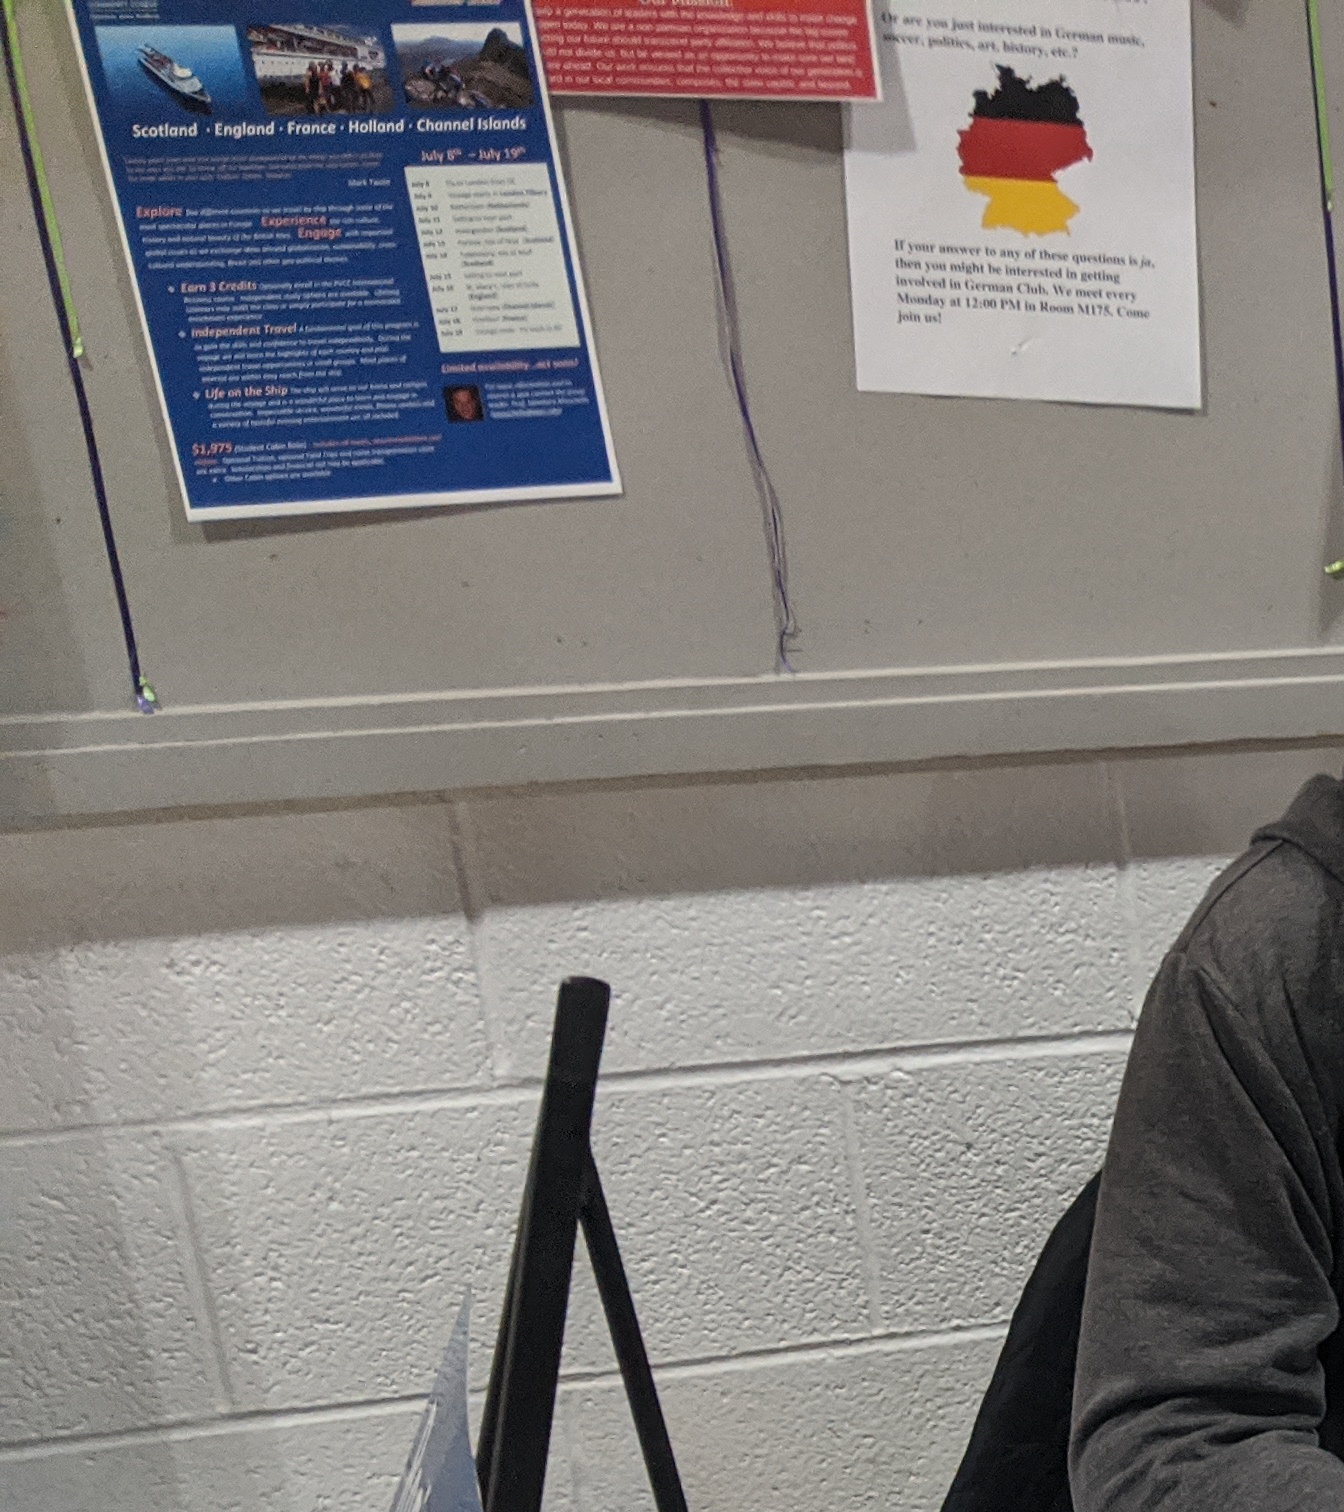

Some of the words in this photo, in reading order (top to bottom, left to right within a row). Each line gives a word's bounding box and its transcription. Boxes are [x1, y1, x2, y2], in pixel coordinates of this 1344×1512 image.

[133, 122, 197, 137] Scotland
[215, 121, 274, 138] England
[287, 121, 335, 134] France
[349, 119, 403, 132] Holland
[417, 117, 473, 131] Channel
[478, 116, 525, 129] Islands
[210, 282, 216, 292] 3
[898, 310, 920, 323] join
[924, 312, 941, 323] us!
[206, 388, 225, 400] Life
[244, 386, 261, 397] the
[265, 386, 288, 397] Ship
